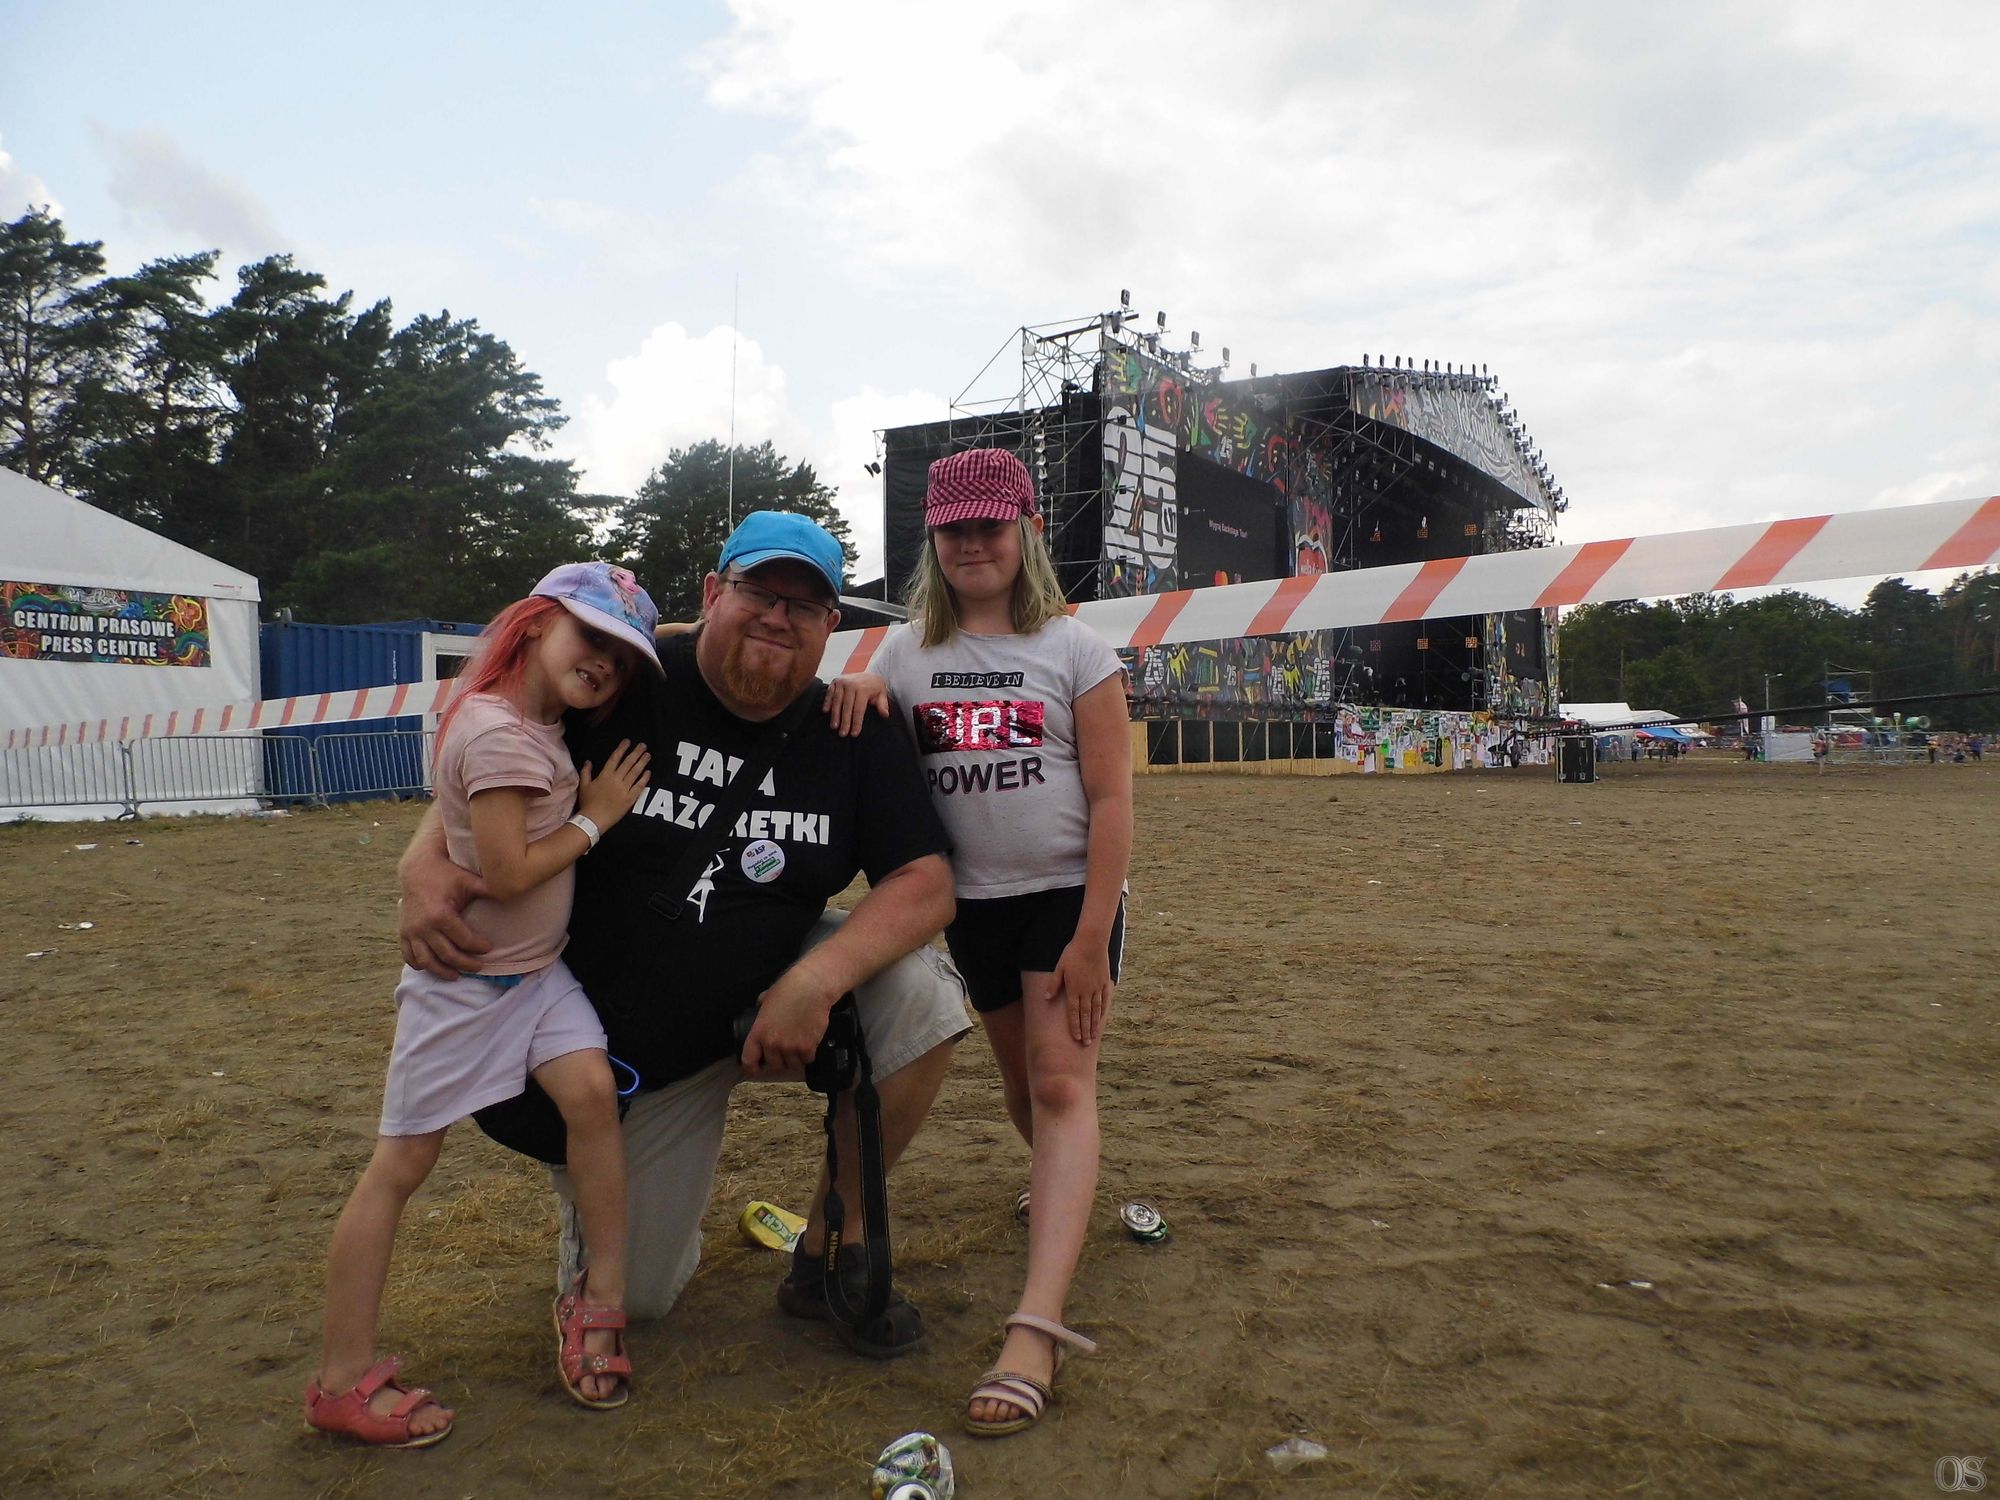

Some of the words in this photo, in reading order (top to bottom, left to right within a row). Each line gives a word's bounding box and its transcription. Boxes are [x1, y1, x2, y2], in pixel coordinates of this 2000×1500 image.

[14, 610, 94, 632] CENTRUM
[98, 617, 176, 638] PRASOWE
[41, 635, 93, 655] PRESS
[97, 638, 157, 657] CENTRE
[933, 675, 941, 687] I
[945, 674, 1000, 687] BELIEVE
[1004, 673, 1021, 686] IN
[927, 756, 1046, 795] POWER
